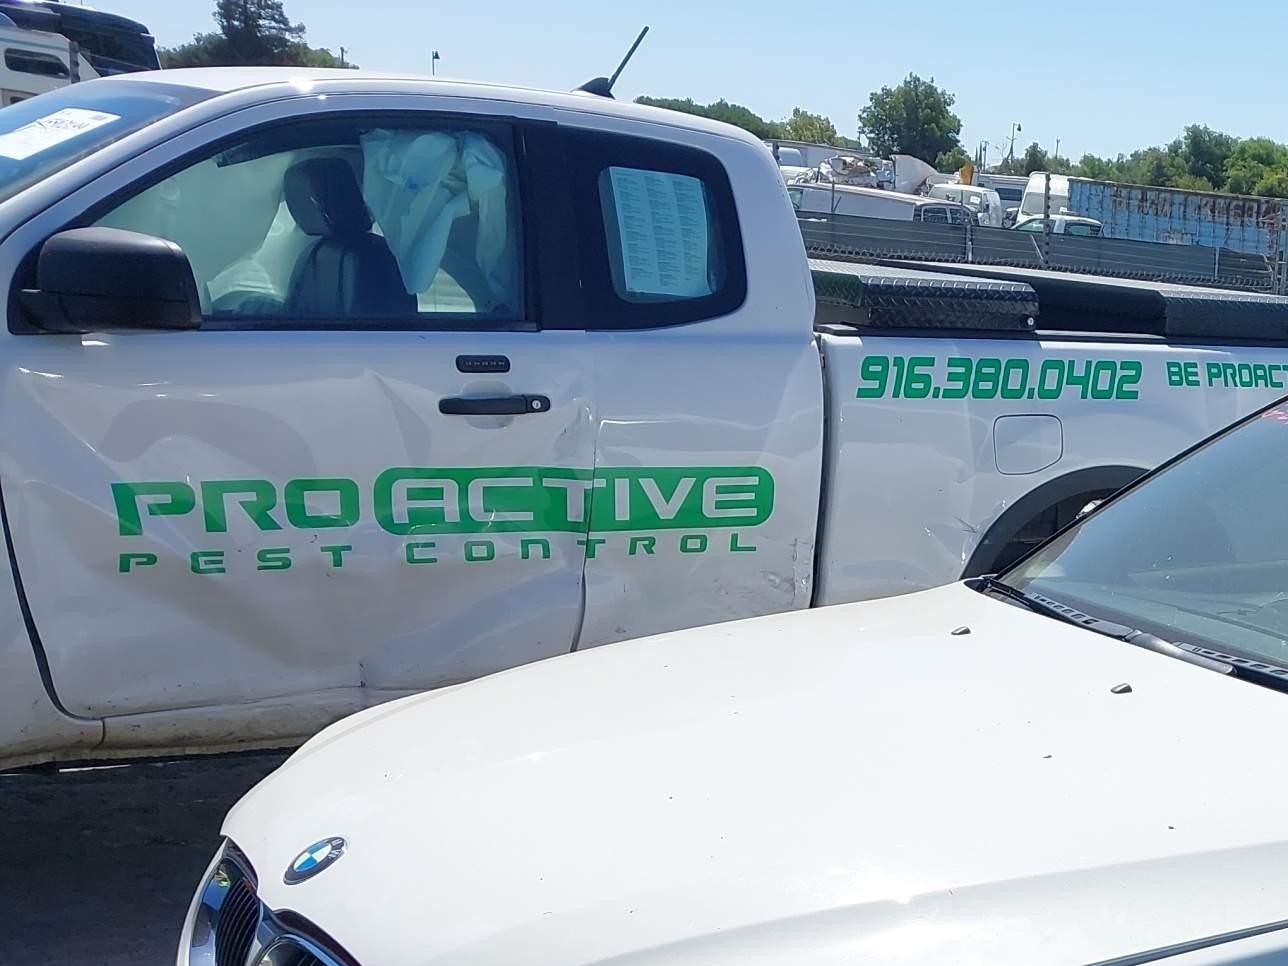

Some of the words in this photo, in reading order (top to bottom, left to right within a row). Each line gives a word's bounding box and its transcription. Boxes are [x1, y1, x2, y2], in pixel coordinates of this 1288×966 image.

[856, 355, 1143, 400] 916.380.0402
[1166, 361, 1201, 387] BE
[118, 545, 353, 574] PEST
[405, 532, 758, 565] CONTROL
